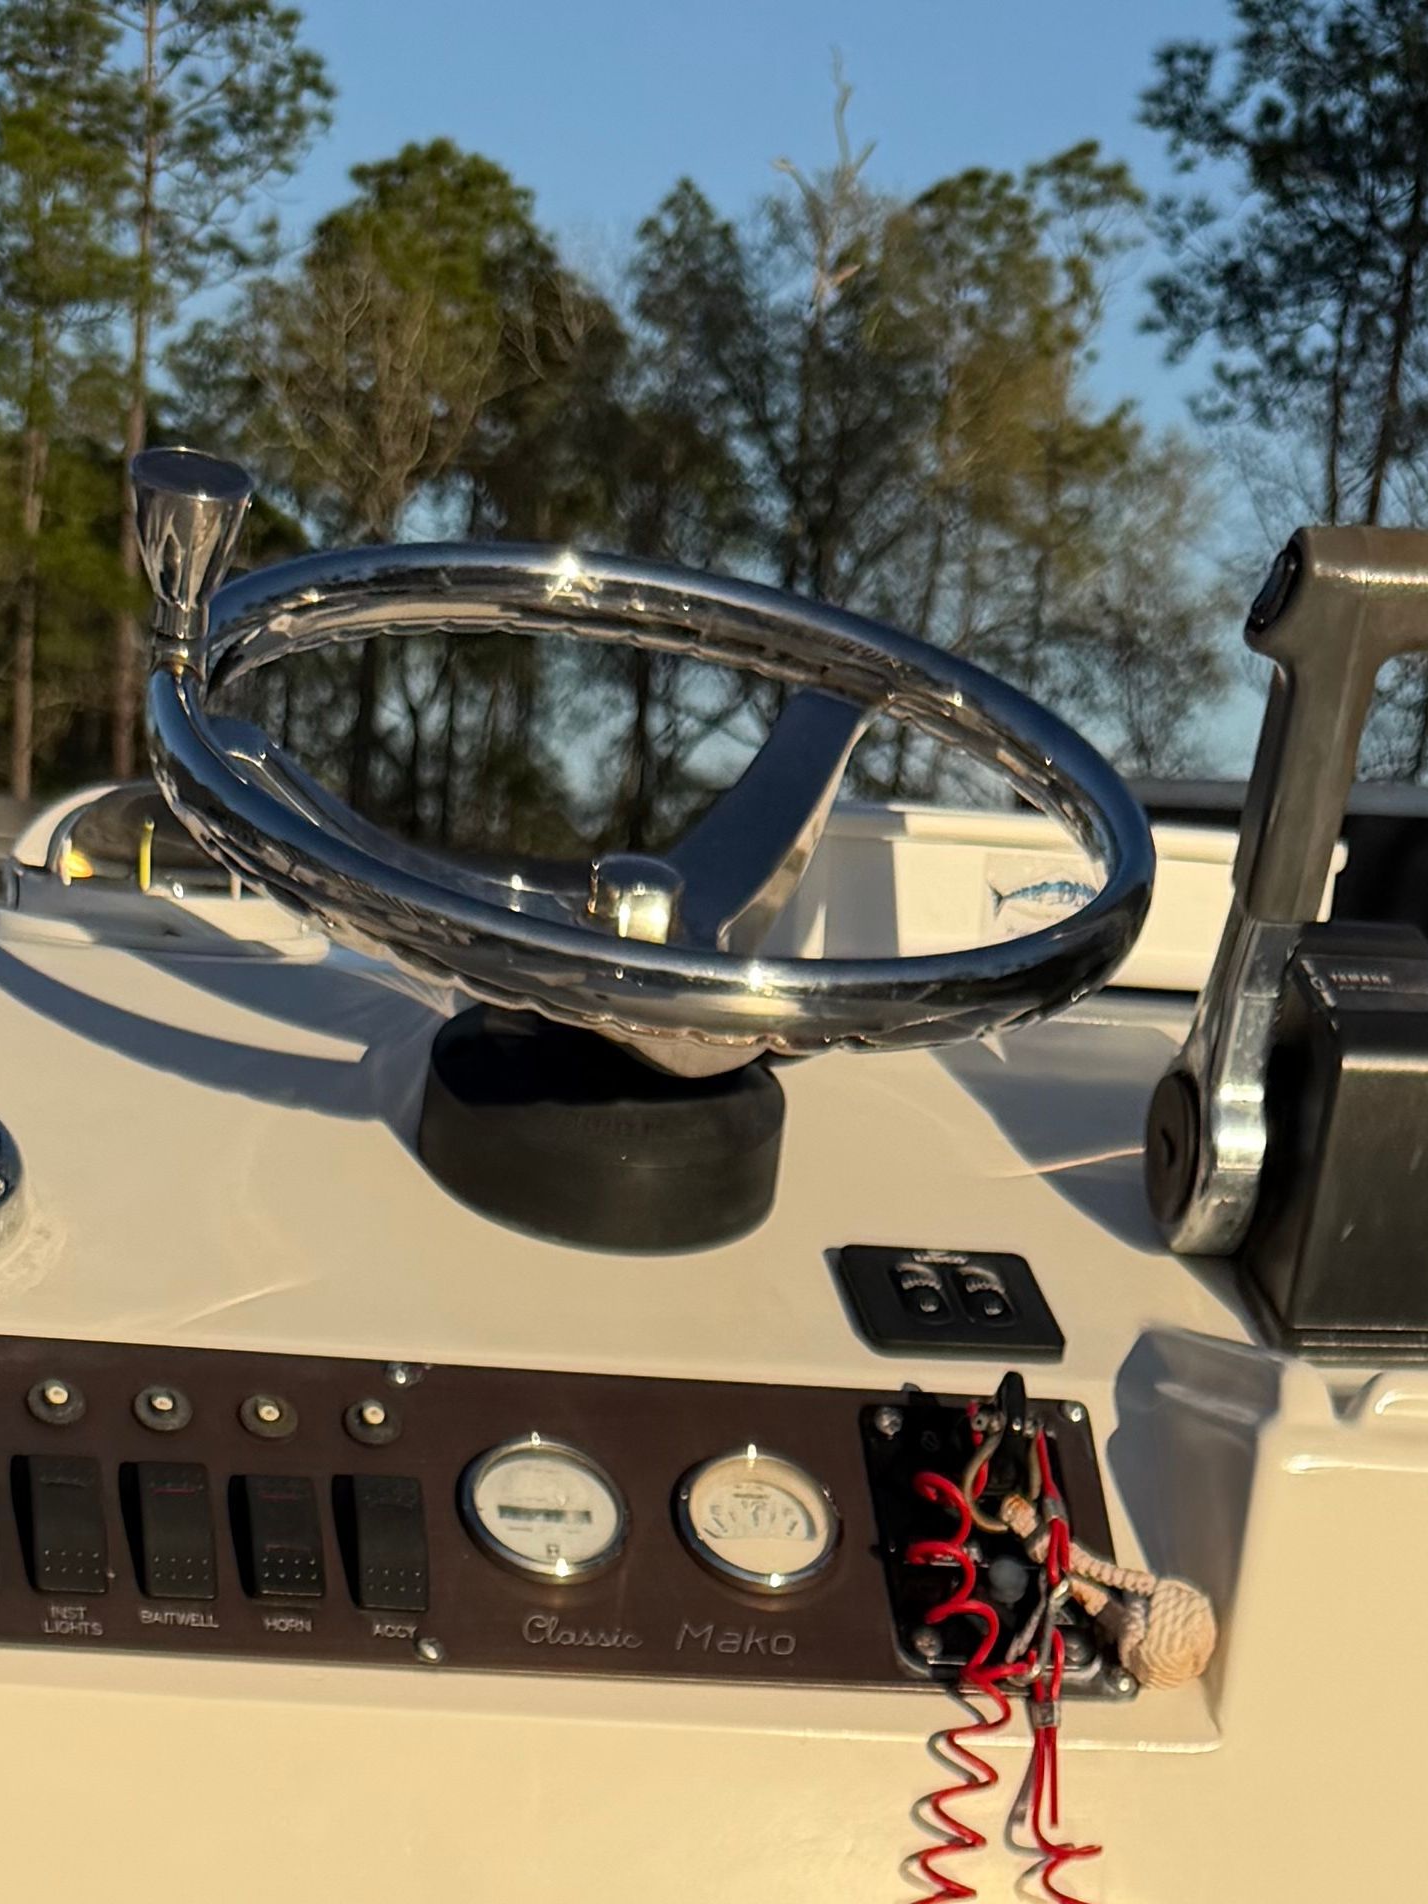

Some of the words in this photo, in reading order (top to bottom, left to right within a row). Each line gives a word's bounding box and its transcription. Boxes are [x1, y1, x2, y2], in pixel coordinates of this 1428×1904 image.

[49, 1604, 88, 1620] INST
[139, 1609, 221, 1629] BAITWELL
[43, 1619, 104, 1636] LIGHTS
[263, 1617, 313, 1633] HORN
[373, 1623, 418, 1639] ACCY
[522, 1613, 644, 1650] Classic
[675, 1622, 798, 1656] Mako
